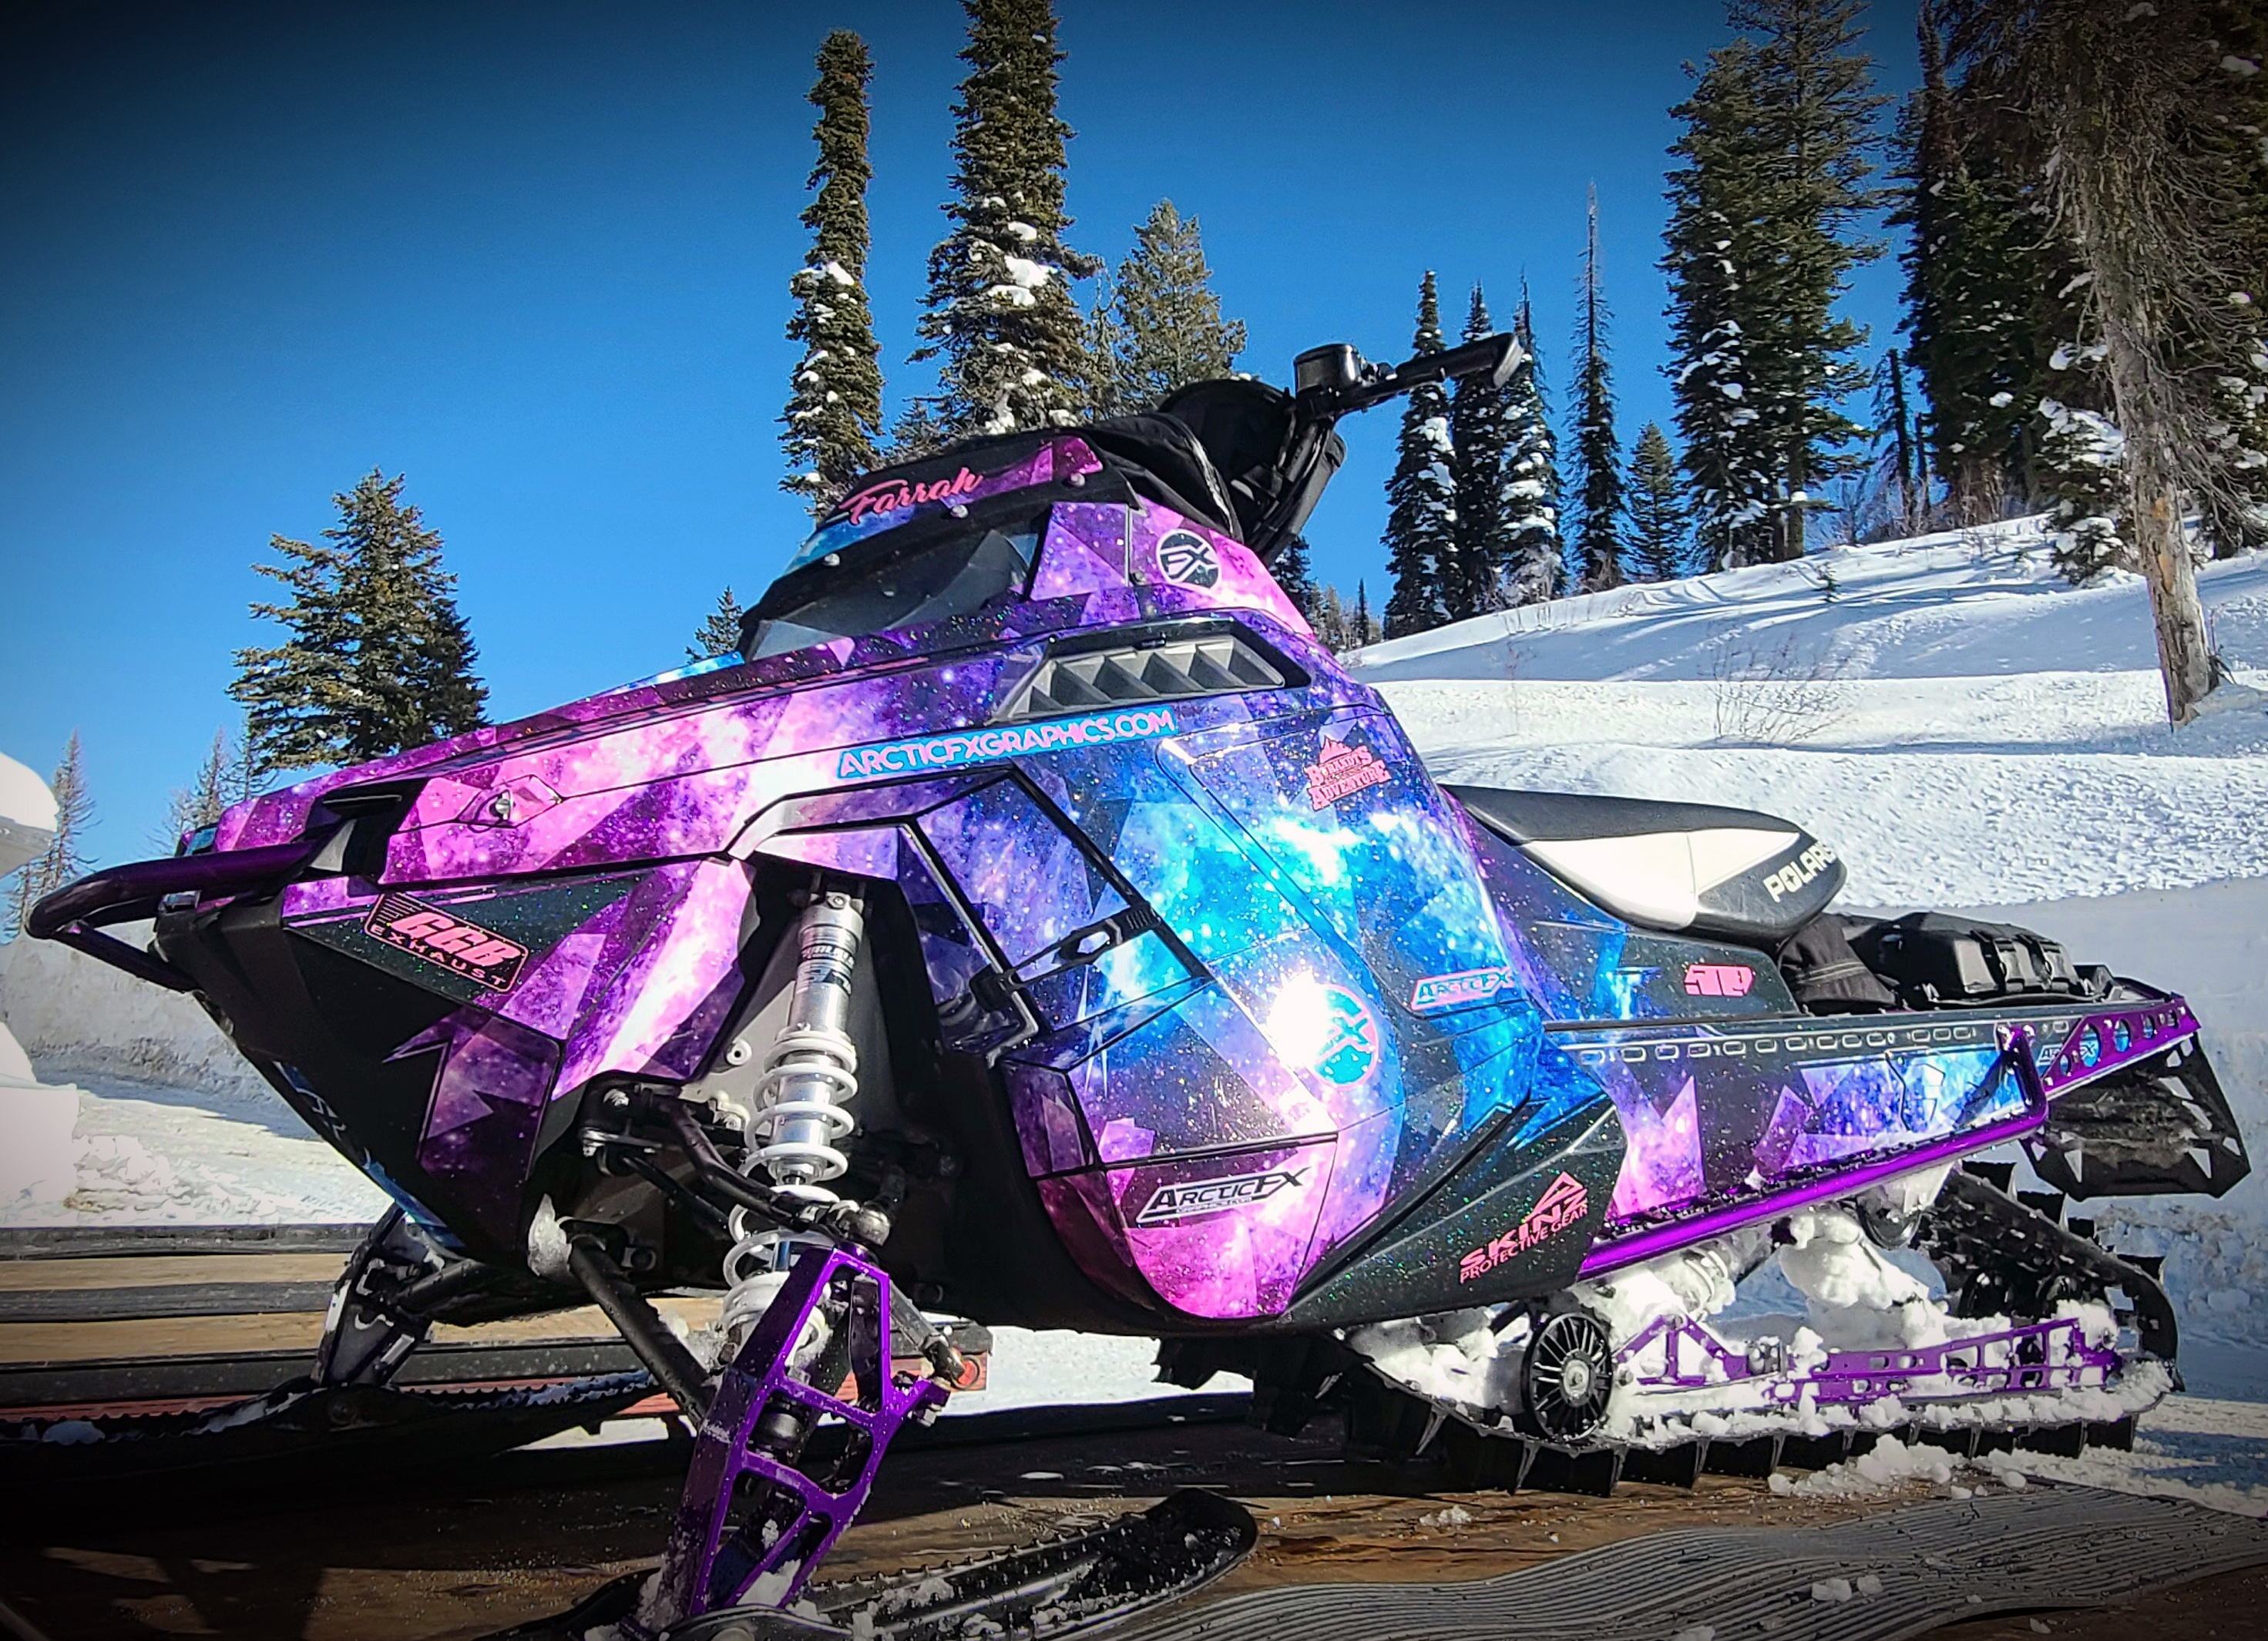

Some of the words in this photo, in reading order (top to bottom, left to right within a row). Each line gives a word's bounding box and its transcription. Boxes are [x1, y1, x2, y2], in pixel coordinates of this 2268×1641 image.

[838, 467, 983, 525] Farrah
[839, 710, 1175, 777] ARCTICFXGRAPHICS.COM
[1308, 760, 1393, 811] ADVENTURE
[370, 924, 506, 985] EXHAUST
[1460, 1227, 1549, 1284] PROTECTIVE
[1551, 1204, 1588, 1233] GEAR
